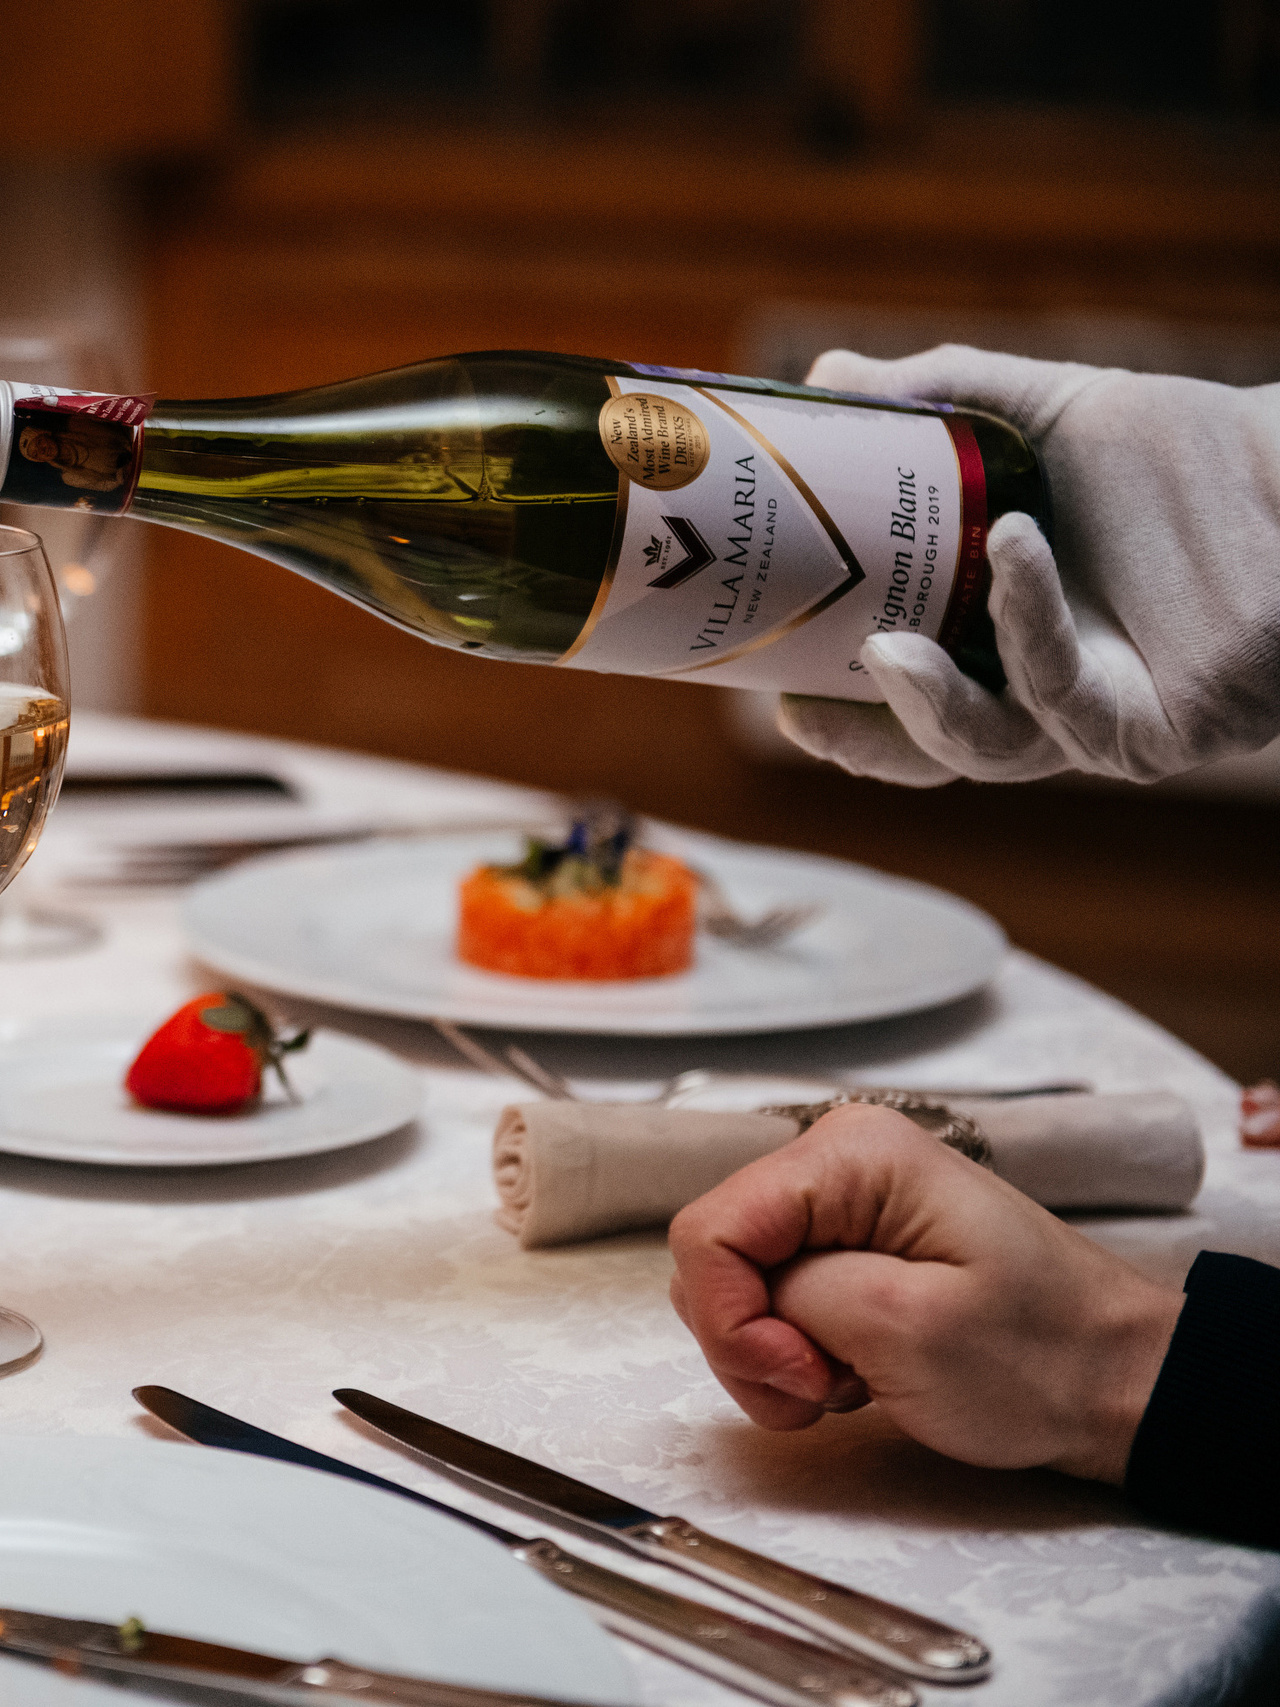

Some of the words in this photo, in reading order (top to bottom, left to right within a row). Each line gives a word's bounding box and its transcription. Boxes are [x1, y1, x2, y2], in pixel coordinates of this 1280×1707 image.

[610, 418, 623, 445] New
[624, 407, 639, 463] Zealand's
[636, 397, 655, 446] Admired
[653, 405, 669, 438] Brand
[673, 416, 688, 467] DRINKS
[642, 448, 655, 481] Most
[658, 440, 671, 475] Wine
[890, 466, 917, 544] Blanc
[689, 574, 745, 651] VILLA
[723, 454, 756, 567] MARIA
[743, 589, 763, 624] NEW
[757, 498, 778, 582] ZEALAND
[908, 534, 939, 633] BOROUGH
[927, 485, 940, 526] 2019
[970, 526, 982, 560] BIN
